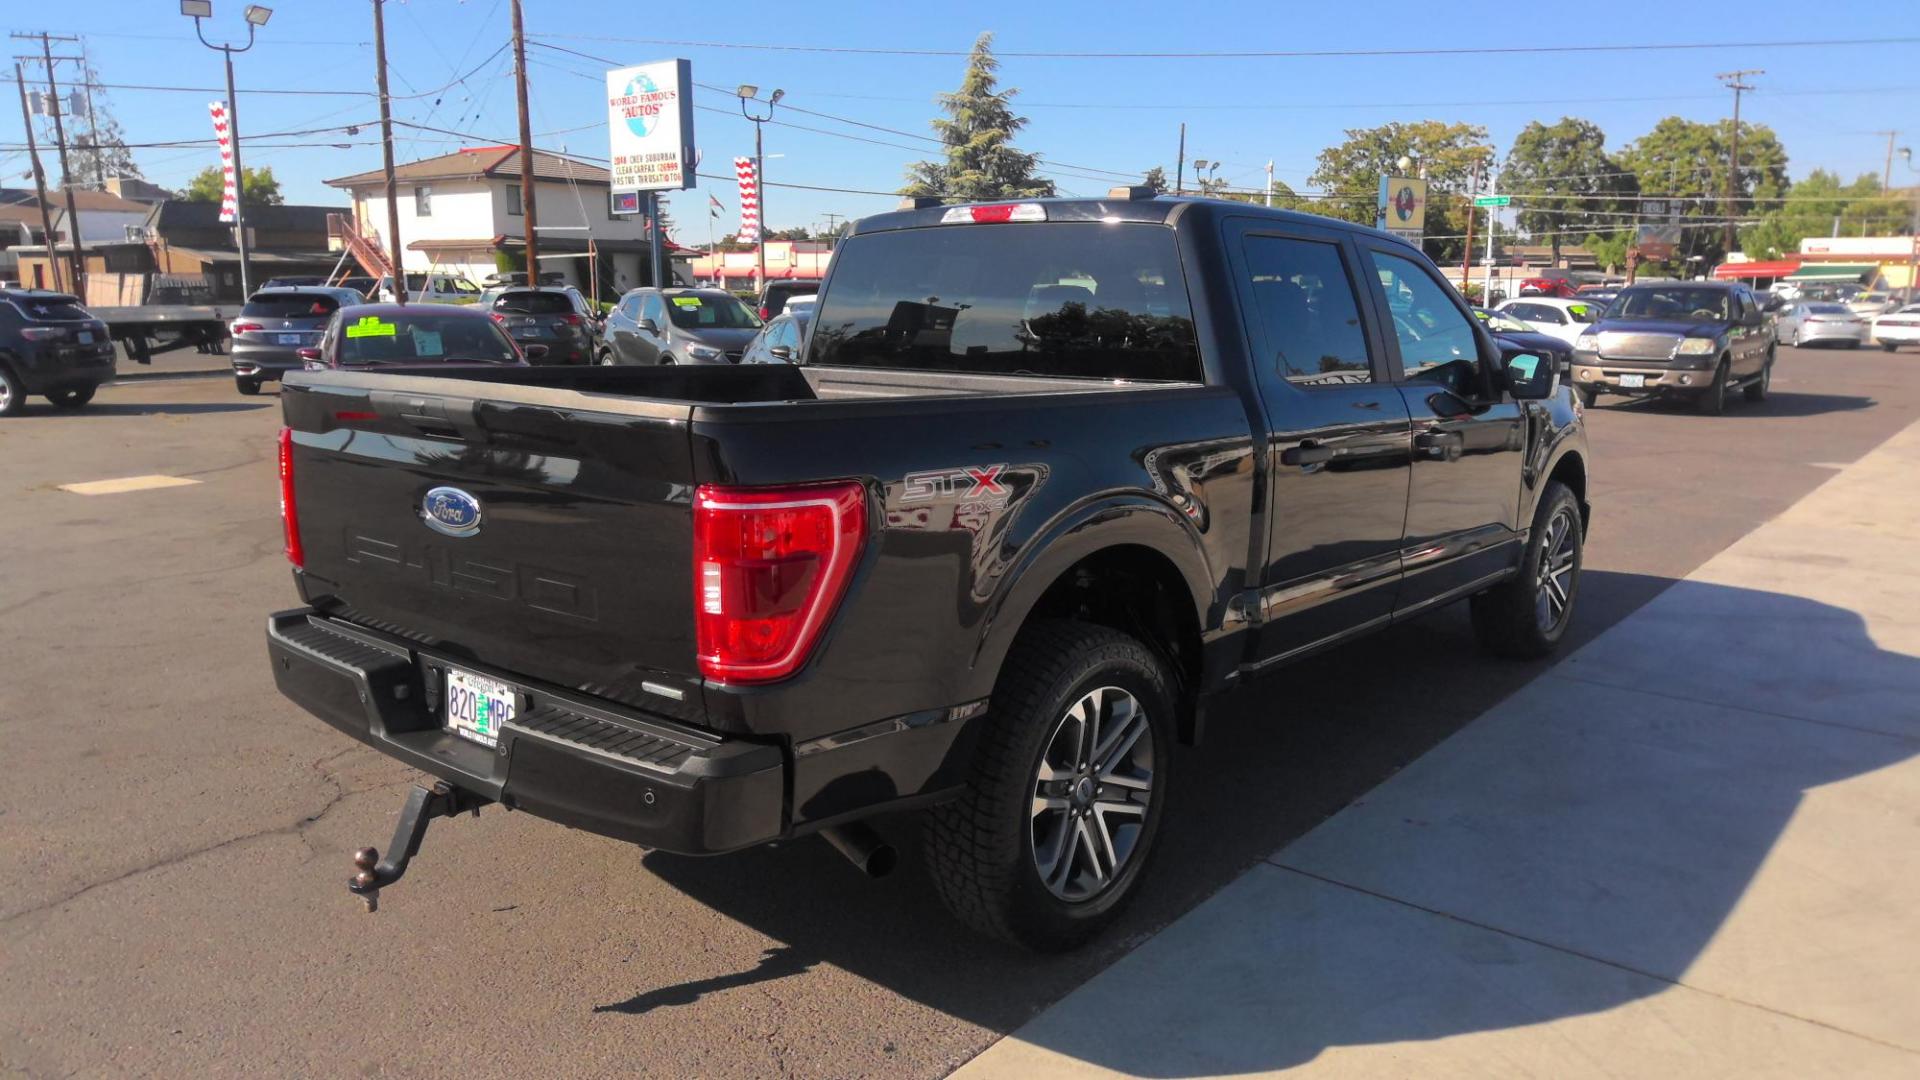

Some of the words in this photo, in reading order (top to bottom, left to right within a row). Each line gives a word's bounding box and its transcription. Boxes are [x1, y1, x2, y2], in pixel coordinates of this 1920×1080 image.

[610, 95, 638, 107] WORLD
[640, 91, 676, 103] FAMOUS
[645, 152, 677, 163] SUBURBAN
[901, 463, 1009, 501] STX
[433, 495, 464, 522] Ford
[450, 684, 477, 723] 820
